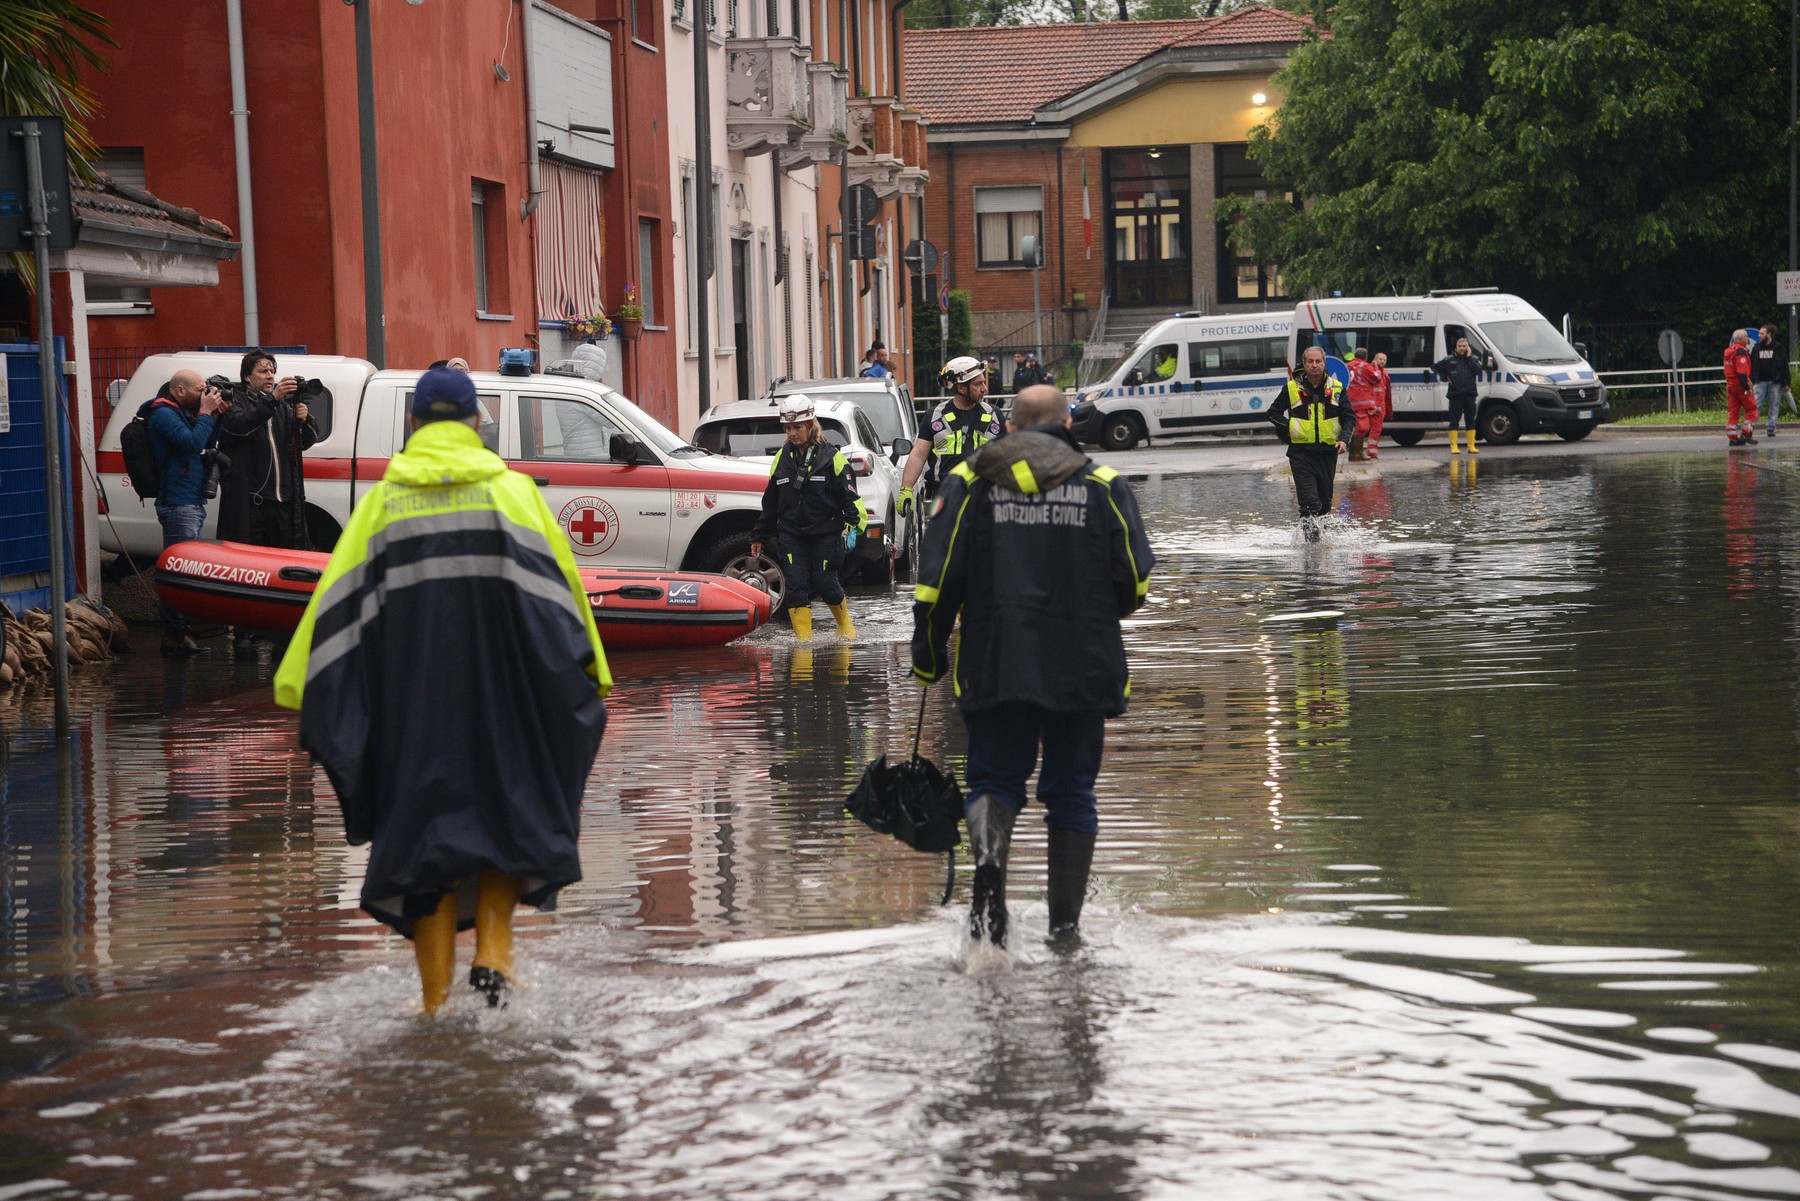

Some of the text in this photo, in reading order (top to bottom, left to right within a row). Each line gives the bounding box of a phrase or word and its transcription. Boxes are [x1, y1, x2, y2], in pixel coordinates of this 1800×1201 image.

[1330, 310, 1423, 322] PROTEZIONE CIVILE
[1201, 322, 1293, 337] PROTEZIONE CIV
[677, 492, 698, 500] MI 20
[1045, 484, 1088, 505] MILANO
[559, 498, 617, 528] CROCE ROSSA ITALIANA
[1052, 504, 1087, 528] CIVILE
[165, 556, 271, 586] SOMMOZZATORI
